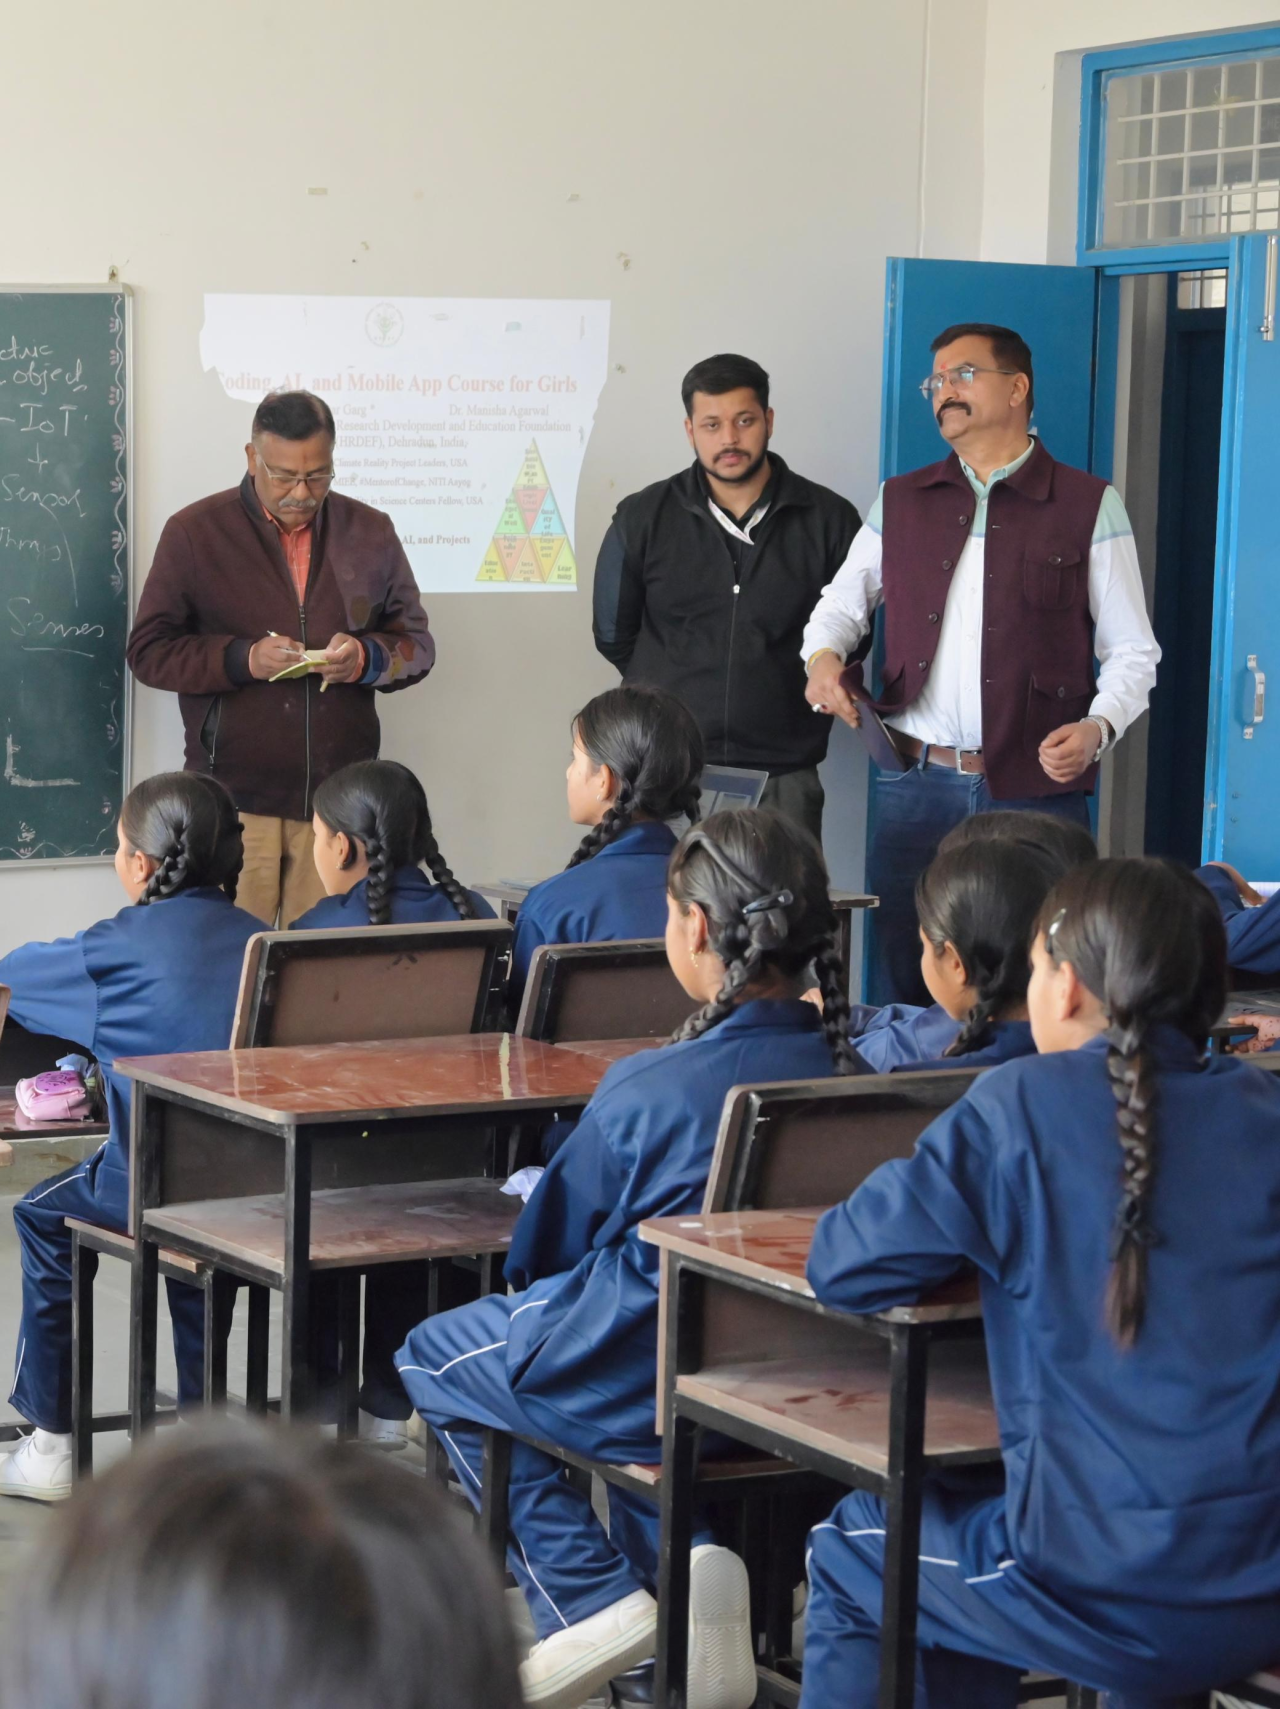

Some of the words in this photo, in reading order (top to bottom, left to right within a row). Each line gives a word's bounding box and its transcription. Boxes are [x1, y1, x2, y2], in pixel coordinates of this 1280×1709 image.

[218, 371, 274, 394] oding,
[312, 372, 342, 391] and
[348, 372, 405, 392] Mobile
[408, 374, 443, 398] App
[448, 374, 503, 393] Course
[509, 373, 534, 393] for
[538, 373, 578, 393] Girls
[343, 403, 367, 418] Garg
[449, 404, 463, 416] Dr.
[466, 404, 507, 416] Manisha
[509, 404, 549, 419] Agarwal
[336, 418, 380, 431] Research
[382, 419, 446, 434] Development
[449, 419, 466, 431] and
[469, 419, 516, 432] Education
[519, 419, 571, 432] Foundation
[363, 458, 388, 470] Reality
[391, 458, 417, 470] Project
[450, 458, 468, 468] USA
[371, 495, 378, 505] in
[380, 495, 408, 505] Science
[409, 495, 437, 505] Centers
[466, 496, 483, 506] USA
[417, 534, 433, 544] and
[436, 534, 471, 547] Projects
